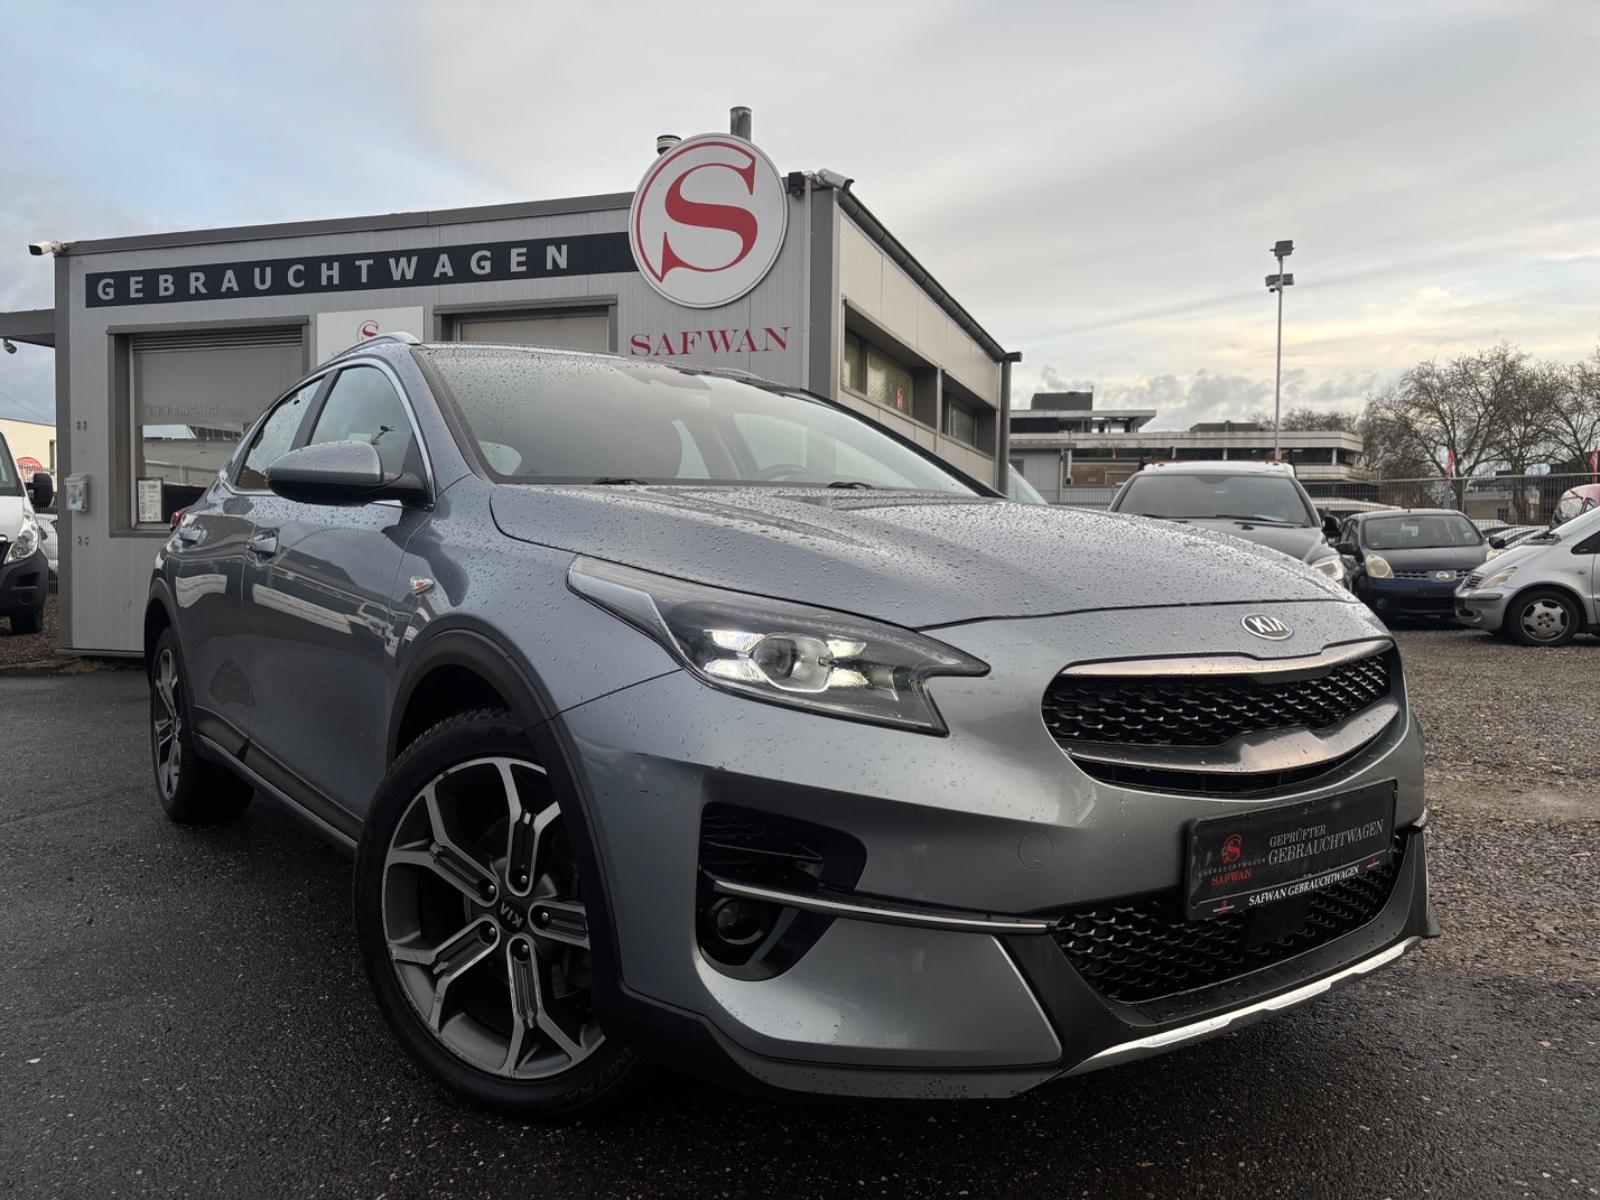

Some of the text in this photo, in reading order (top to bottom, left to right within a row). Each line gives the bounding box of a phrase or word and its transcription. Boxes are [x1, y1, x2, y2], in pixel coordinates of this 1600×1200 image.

[637, 142, 758, 283] S
[96, 244, 568, 300] GEBRAUCHTWAGEN
[631, 326, 791, 356] SAFWAN
[1246, 616, 1290, 633] KIA
[1268, 819, 1384, 866] GEBRAUCHTWAGEN
[1210, 868, 1252, 887] SAFWAN
[1248, 864, 1360, 906] SAFWAN GEBRAUCHTWAGEN
[500, 901, 522, 928] KIA
